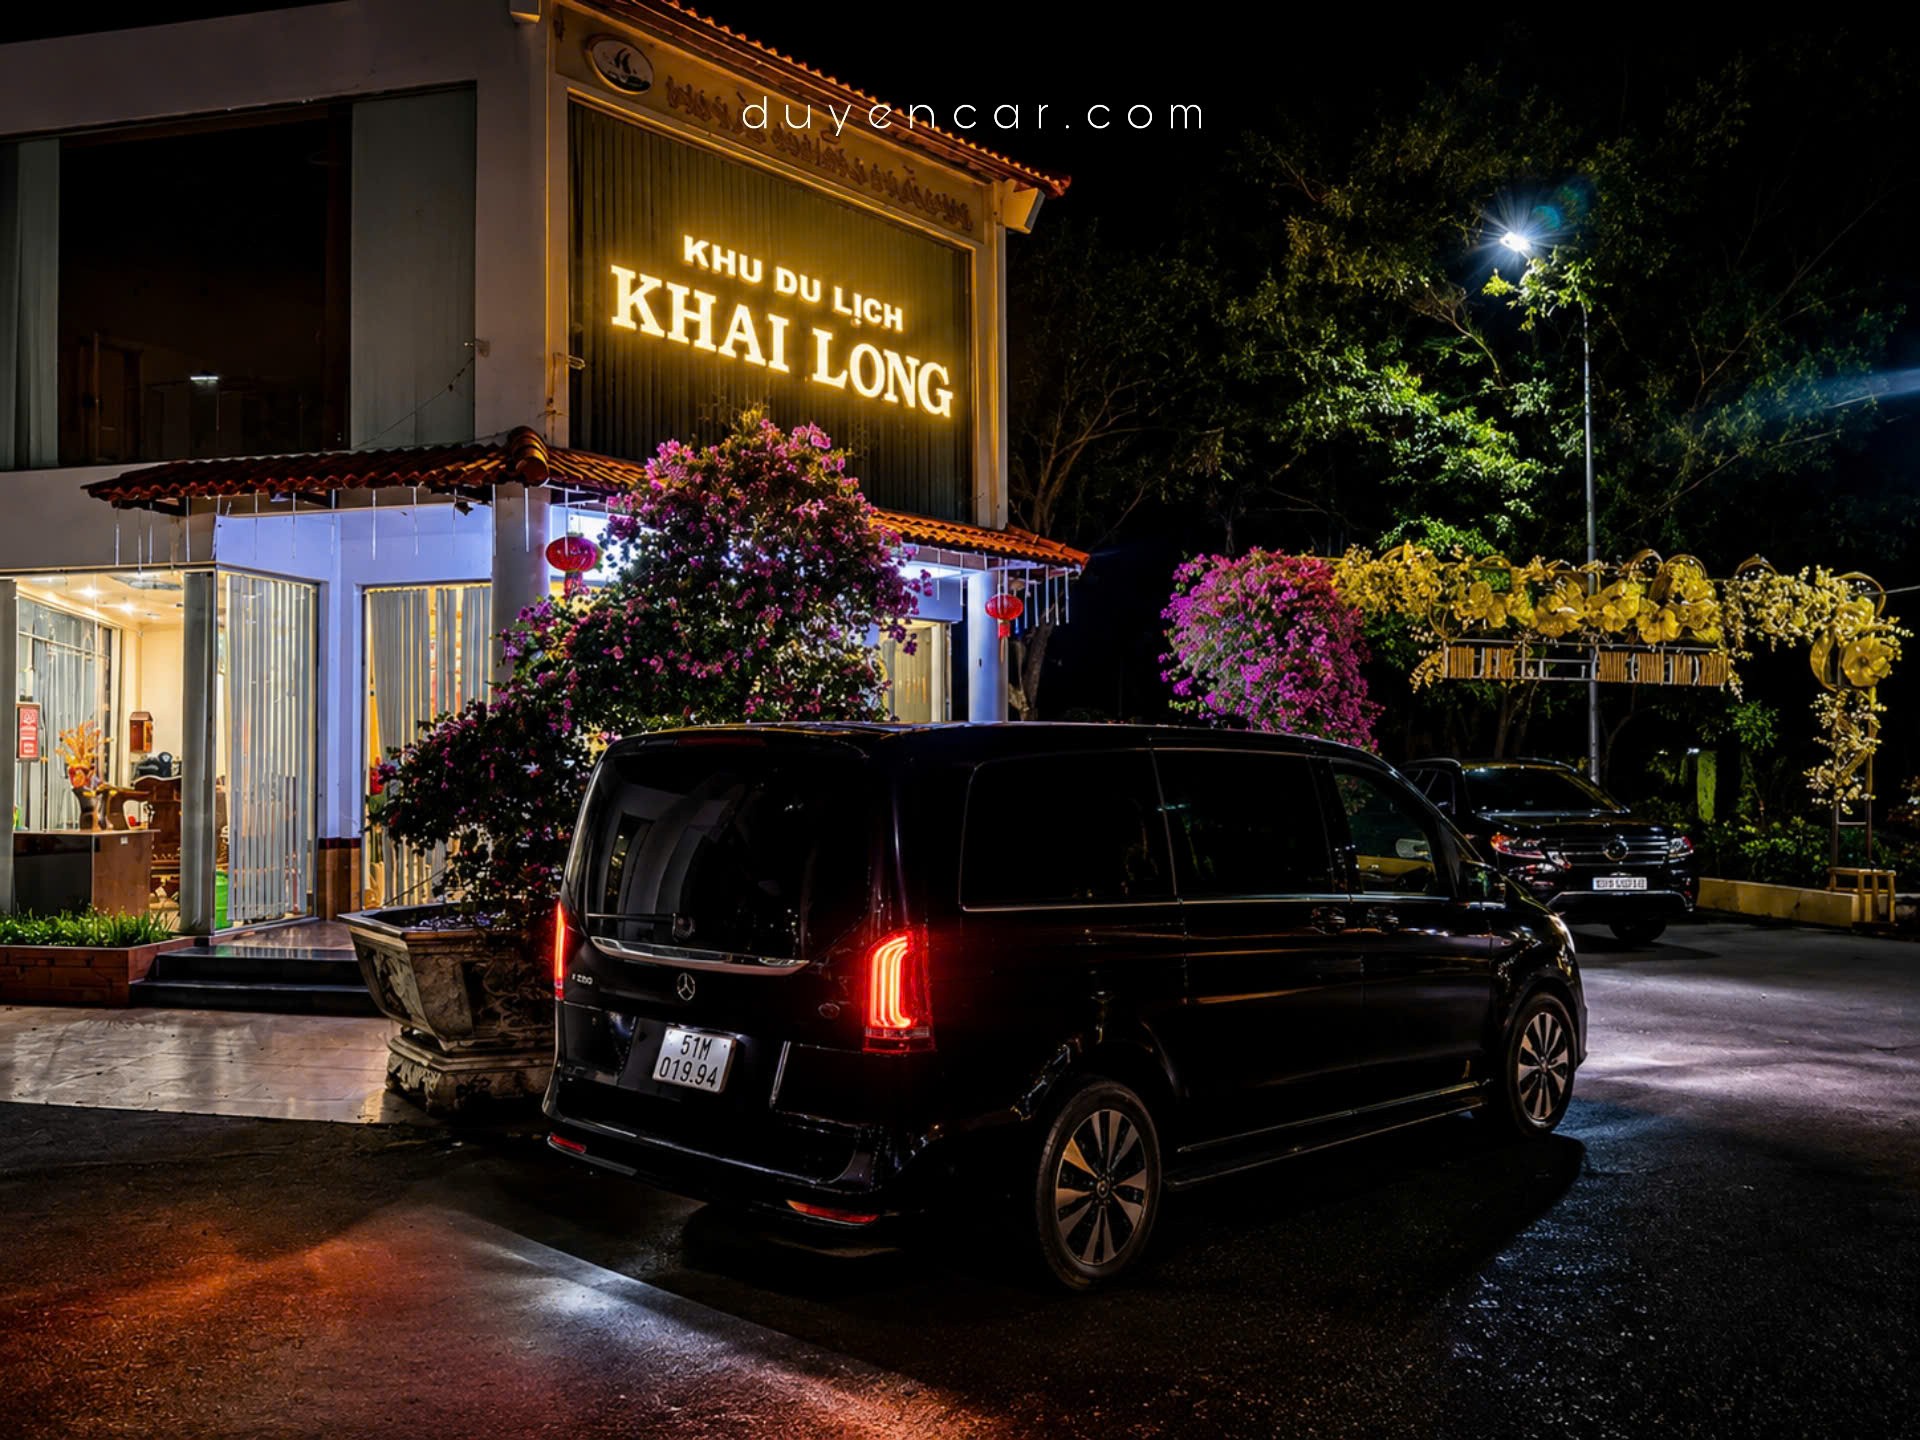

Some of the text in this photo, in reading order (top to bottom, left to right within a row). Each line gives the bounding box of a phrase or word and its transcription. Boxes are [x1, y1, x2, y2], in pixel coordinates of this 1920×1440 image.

[684, 234, 904, 333] KHU DU LỊCH
[610, 264, 953, 419] KHAI LONG
[659, 1056, 719, 1089] 019.94
[681, 1034, 713, 1061] 51M
